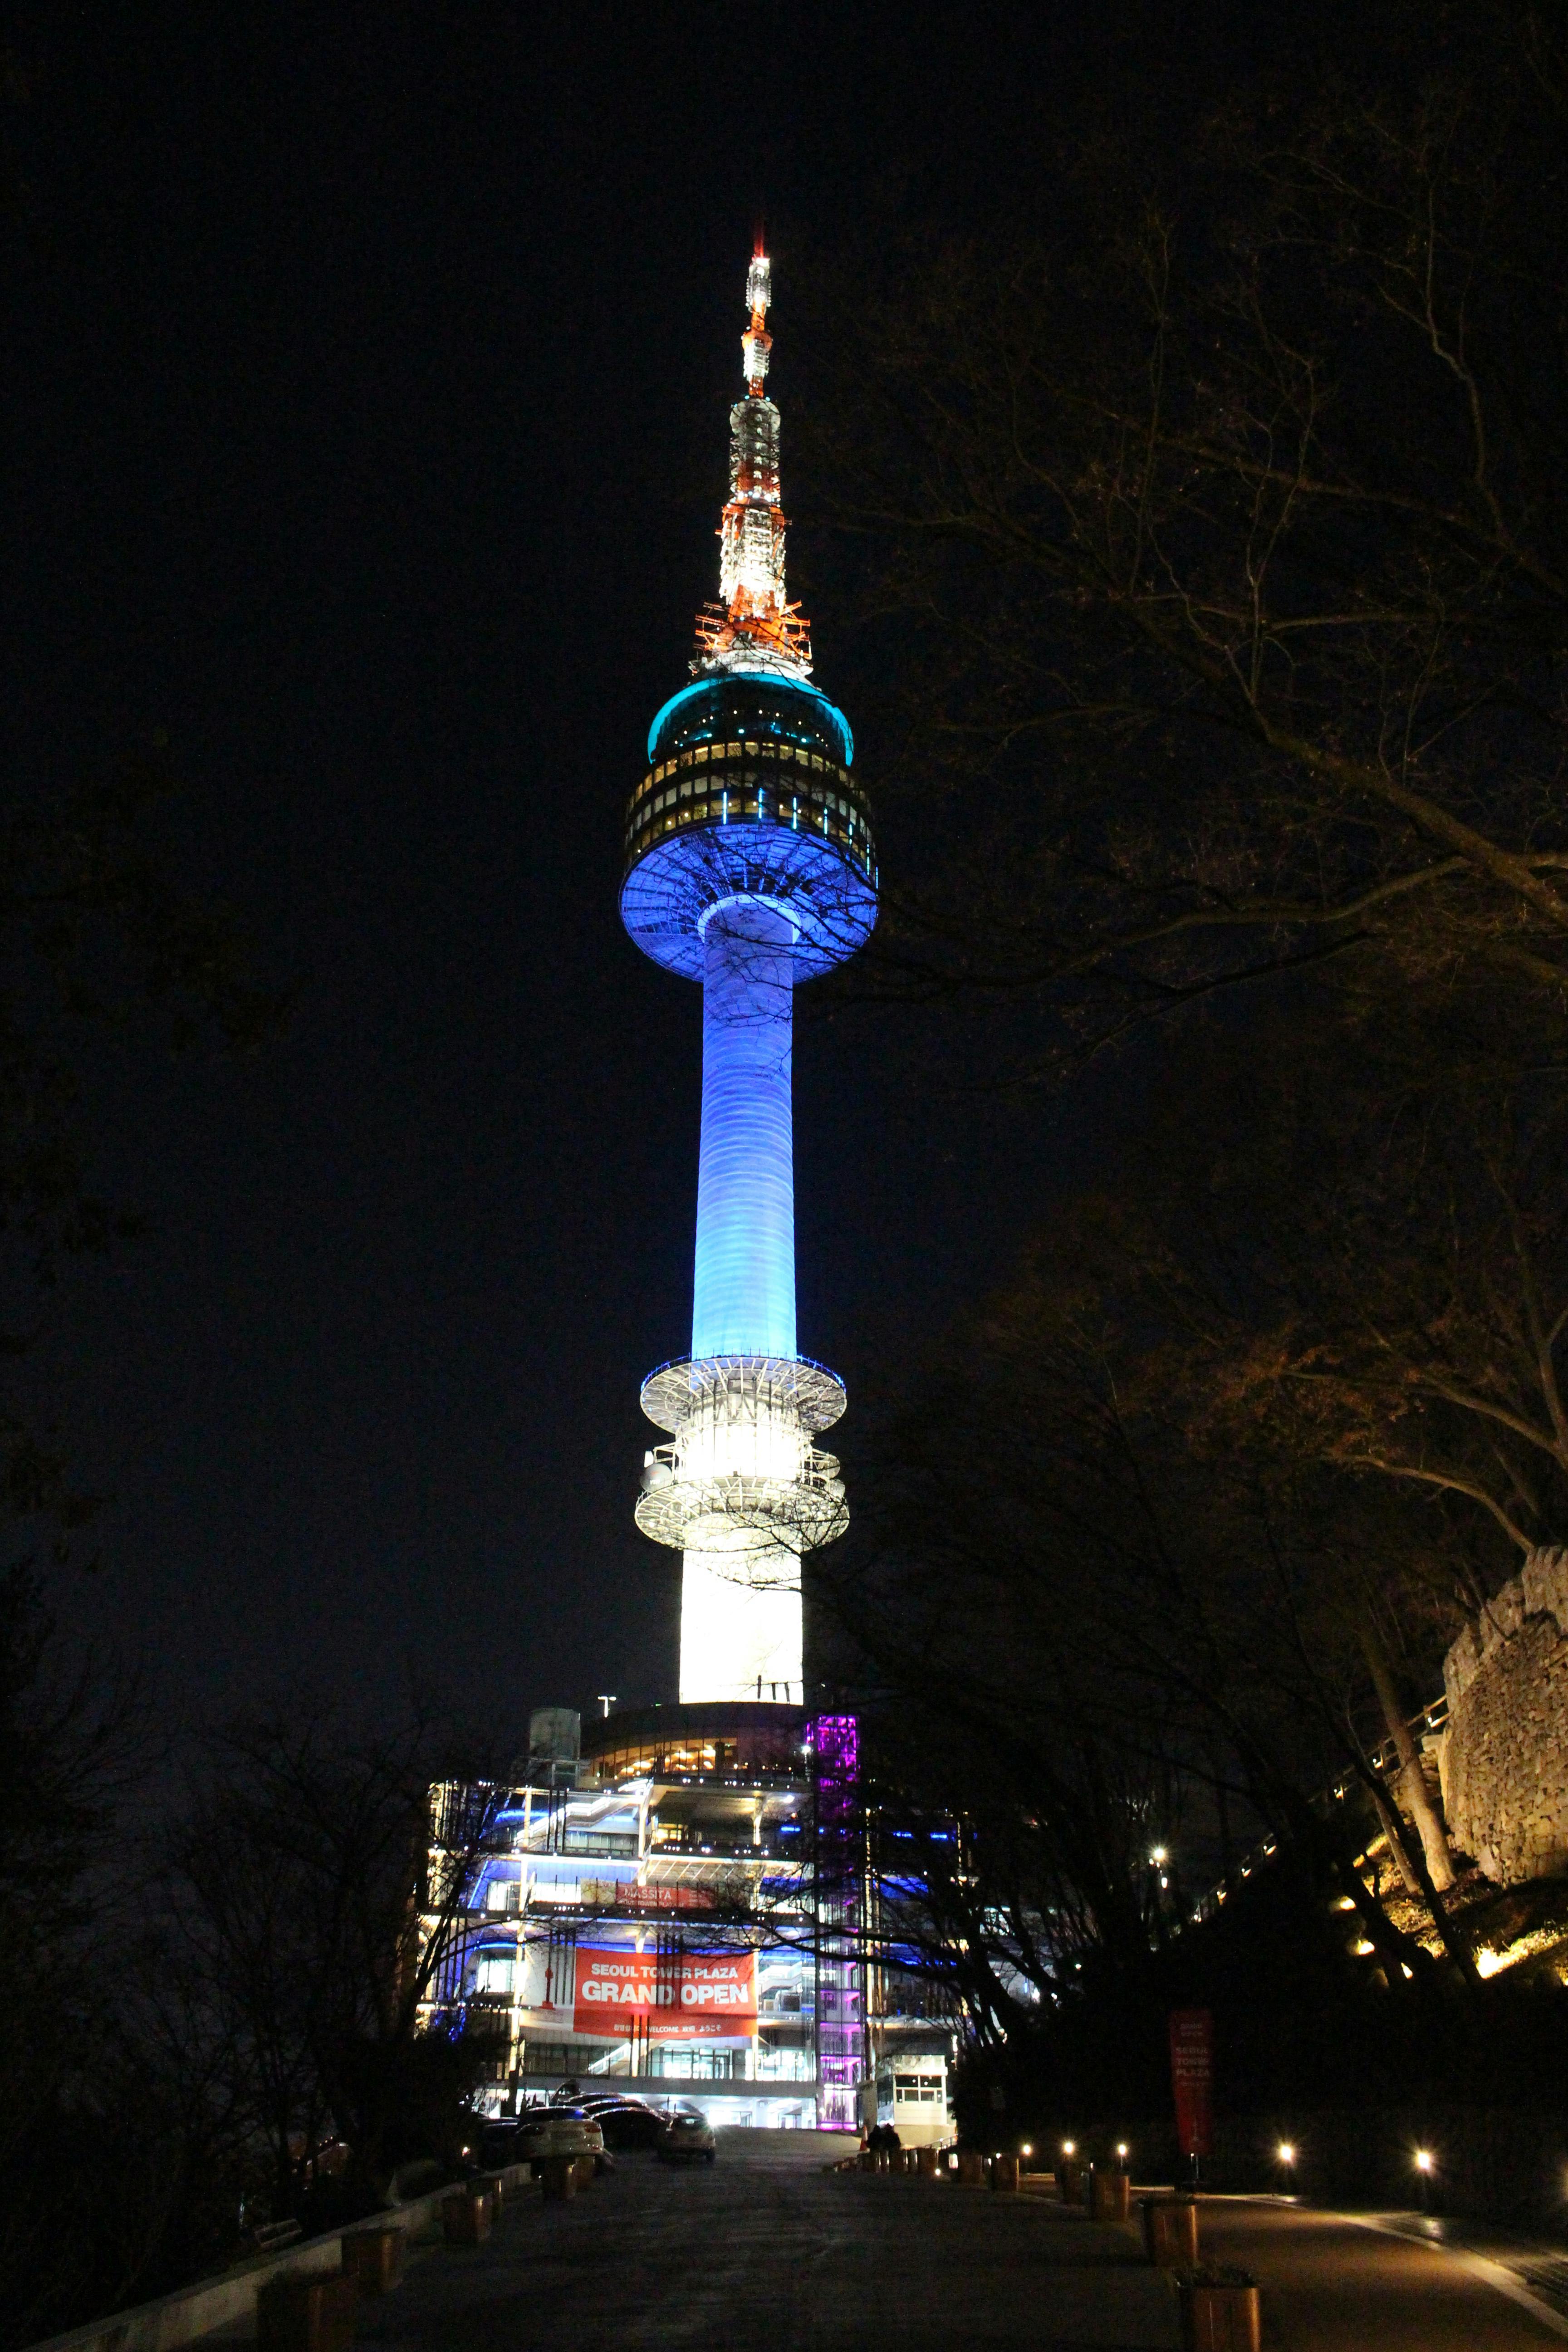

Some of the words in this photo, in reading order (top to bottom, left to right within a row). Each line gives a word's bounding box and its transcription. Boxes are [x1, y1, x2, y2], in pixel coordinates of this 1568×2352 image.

[624, 1887, 672, 1900] MASSITA
[591, 1963, 639, 1977] SEOUL
[640, 1965, 692, 1979] TOWER
[694, 1967, 738, 1979] PLAZA
[582, 1980, 676, 2005] GRAND
[681, 1983, 749, 2005] OPEN
